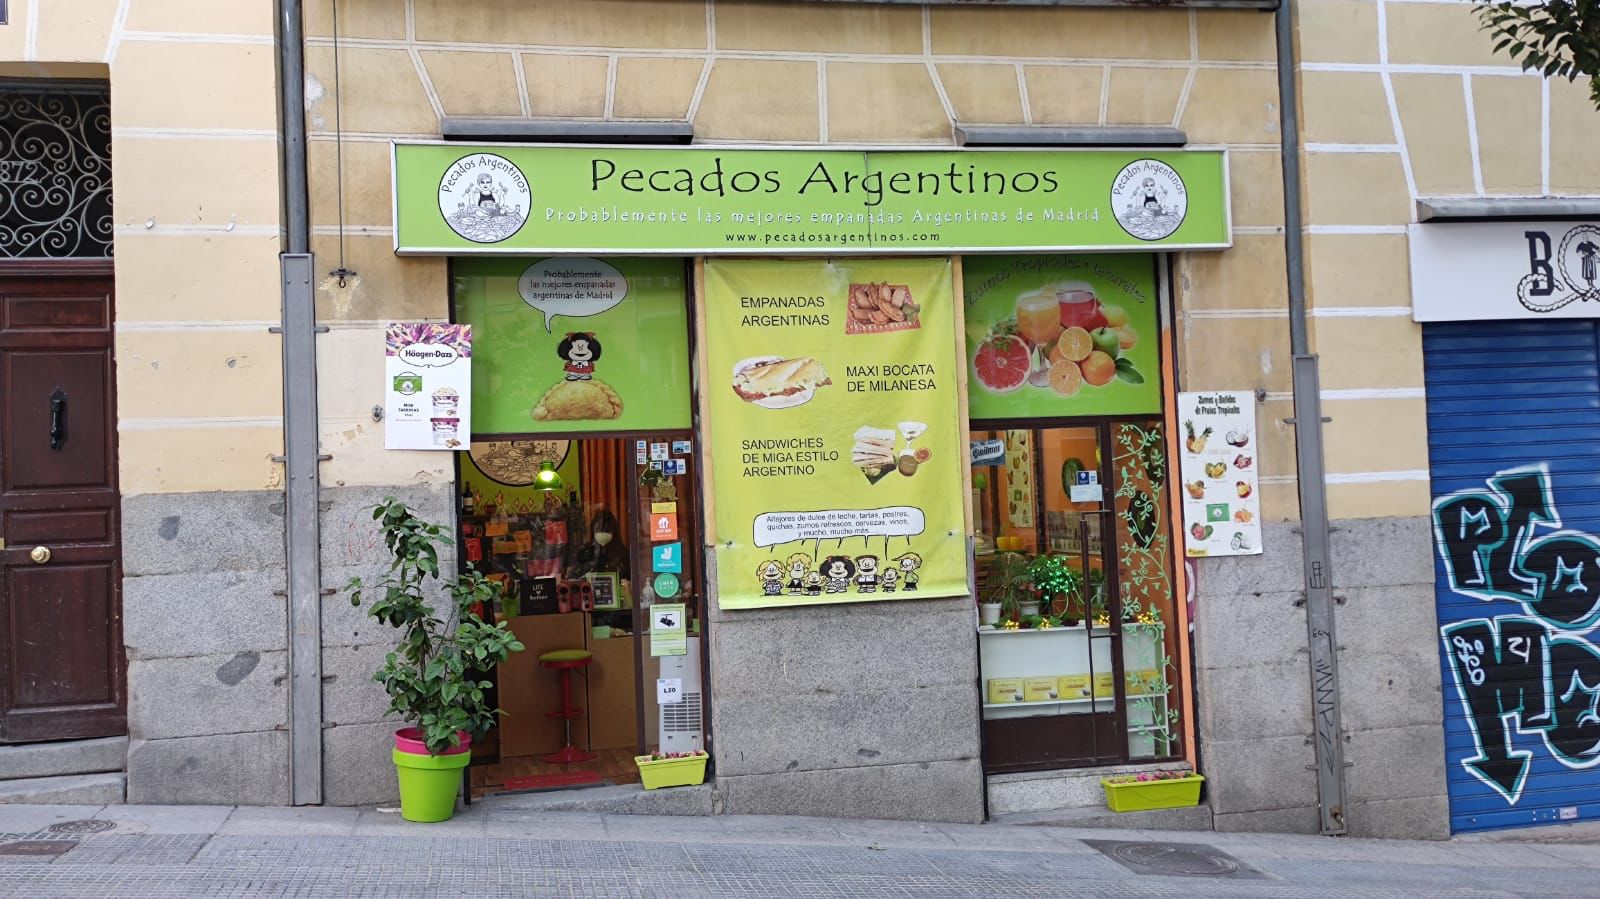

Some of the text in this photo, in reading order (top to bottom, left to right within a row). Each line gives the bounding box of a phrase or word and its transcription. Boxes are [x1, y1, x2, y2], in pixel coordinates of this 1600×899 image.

[441, 156, 528, 194] Pecados Argentinos
[1113, 161, 1184, 195] Pecados Argentinos
[592, 157, 1059, 207] Pecados Argentinos
[545, 207, 1101, 227] Probablemente las mejores empanadas Argentinas de Madrid
[725, 231, 940, 244] www.pecadosargentinos.com
[544, 269, 602, 278] Probablemente
[530, 280, 616, 290] las mejores empanadas
[533, 291, 613, 301] argentinas de Madrid
[741, 296, 825, 309] EMPANADAS
[741, 314, 830, 327] ARGENTINAS
[405, 349, 453, 360] Häagen-Dazs
[846, 364, 935, 377] MAXI BOCATA
[847, 379, 936, 392] DE MILANESA
[742, 437, 824, 450] SANDWICHES
[743, 450, 839, 464] DE MIGA ESTILO
[743, 465, 815, 478] ARGENTINO
[797, 514, 806, 522] de
